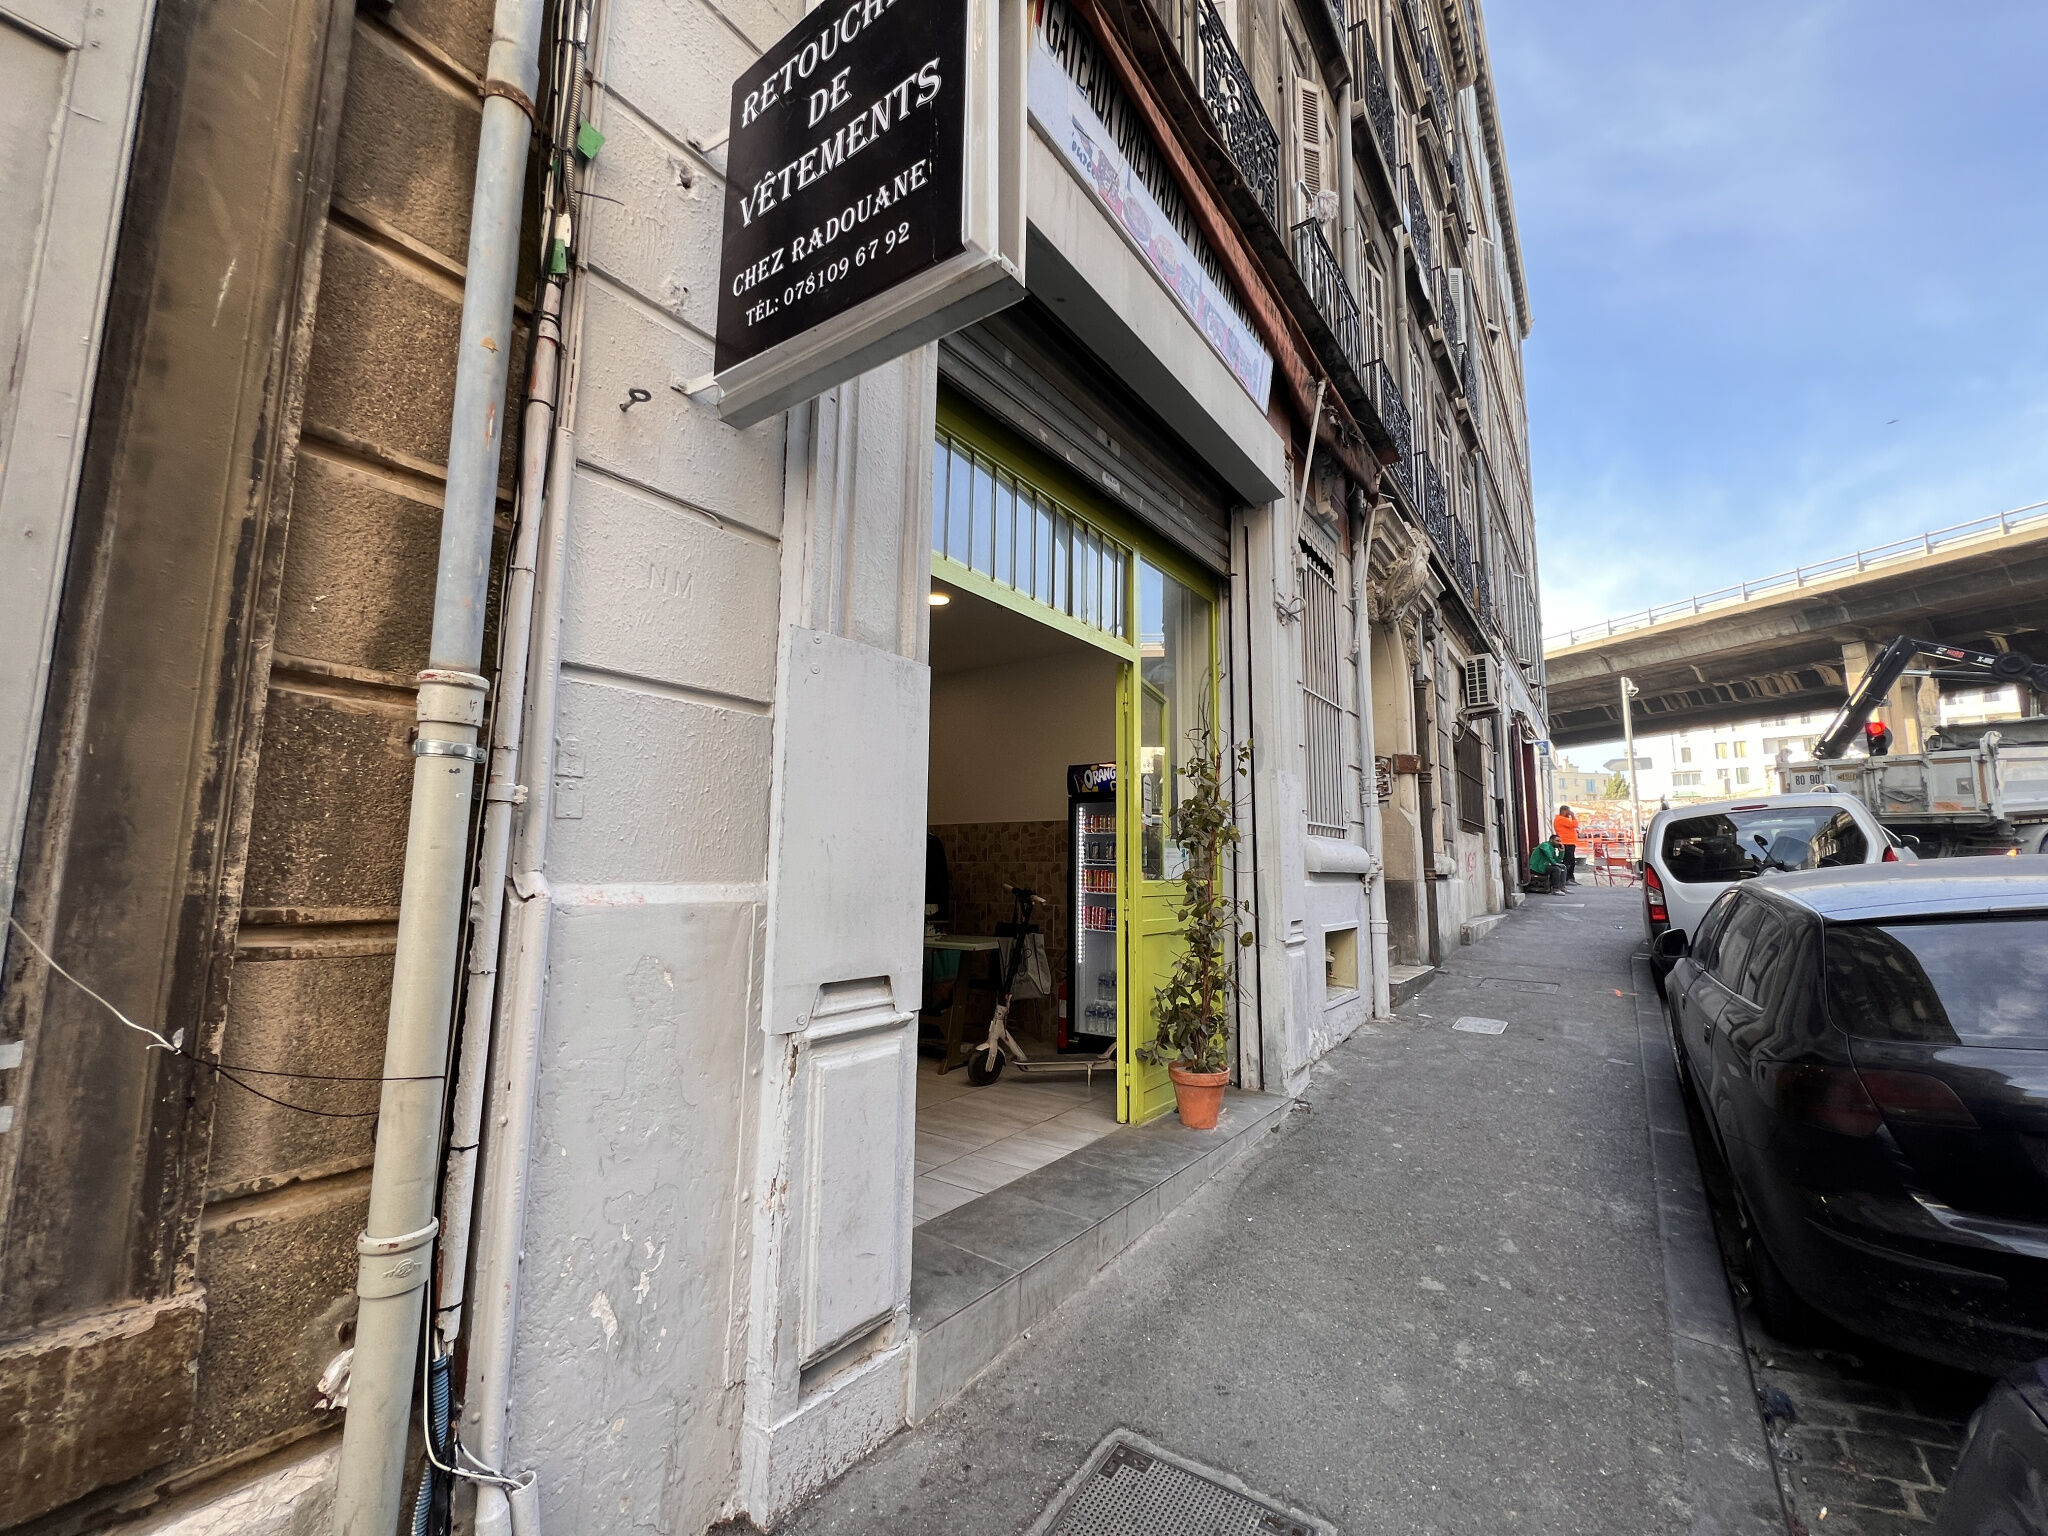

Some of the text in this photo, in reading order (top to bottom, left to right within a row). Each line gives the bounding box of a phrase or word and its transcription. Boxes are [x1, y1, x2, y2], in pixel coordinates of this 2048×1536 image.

[741, 0, 896, 129] RETOUCH
[807, 66, 853, 129] DE
[739, 57, 942, 229] VÊTEMENTS
[733, 159, 929, 297] CHEZ RADOUANE
[745, 222, 910, 327] TÉL: 078109 67 92
[1084, 768, 1117, 789] ORANG
[1795, 774, 1820, 785] 80 90
